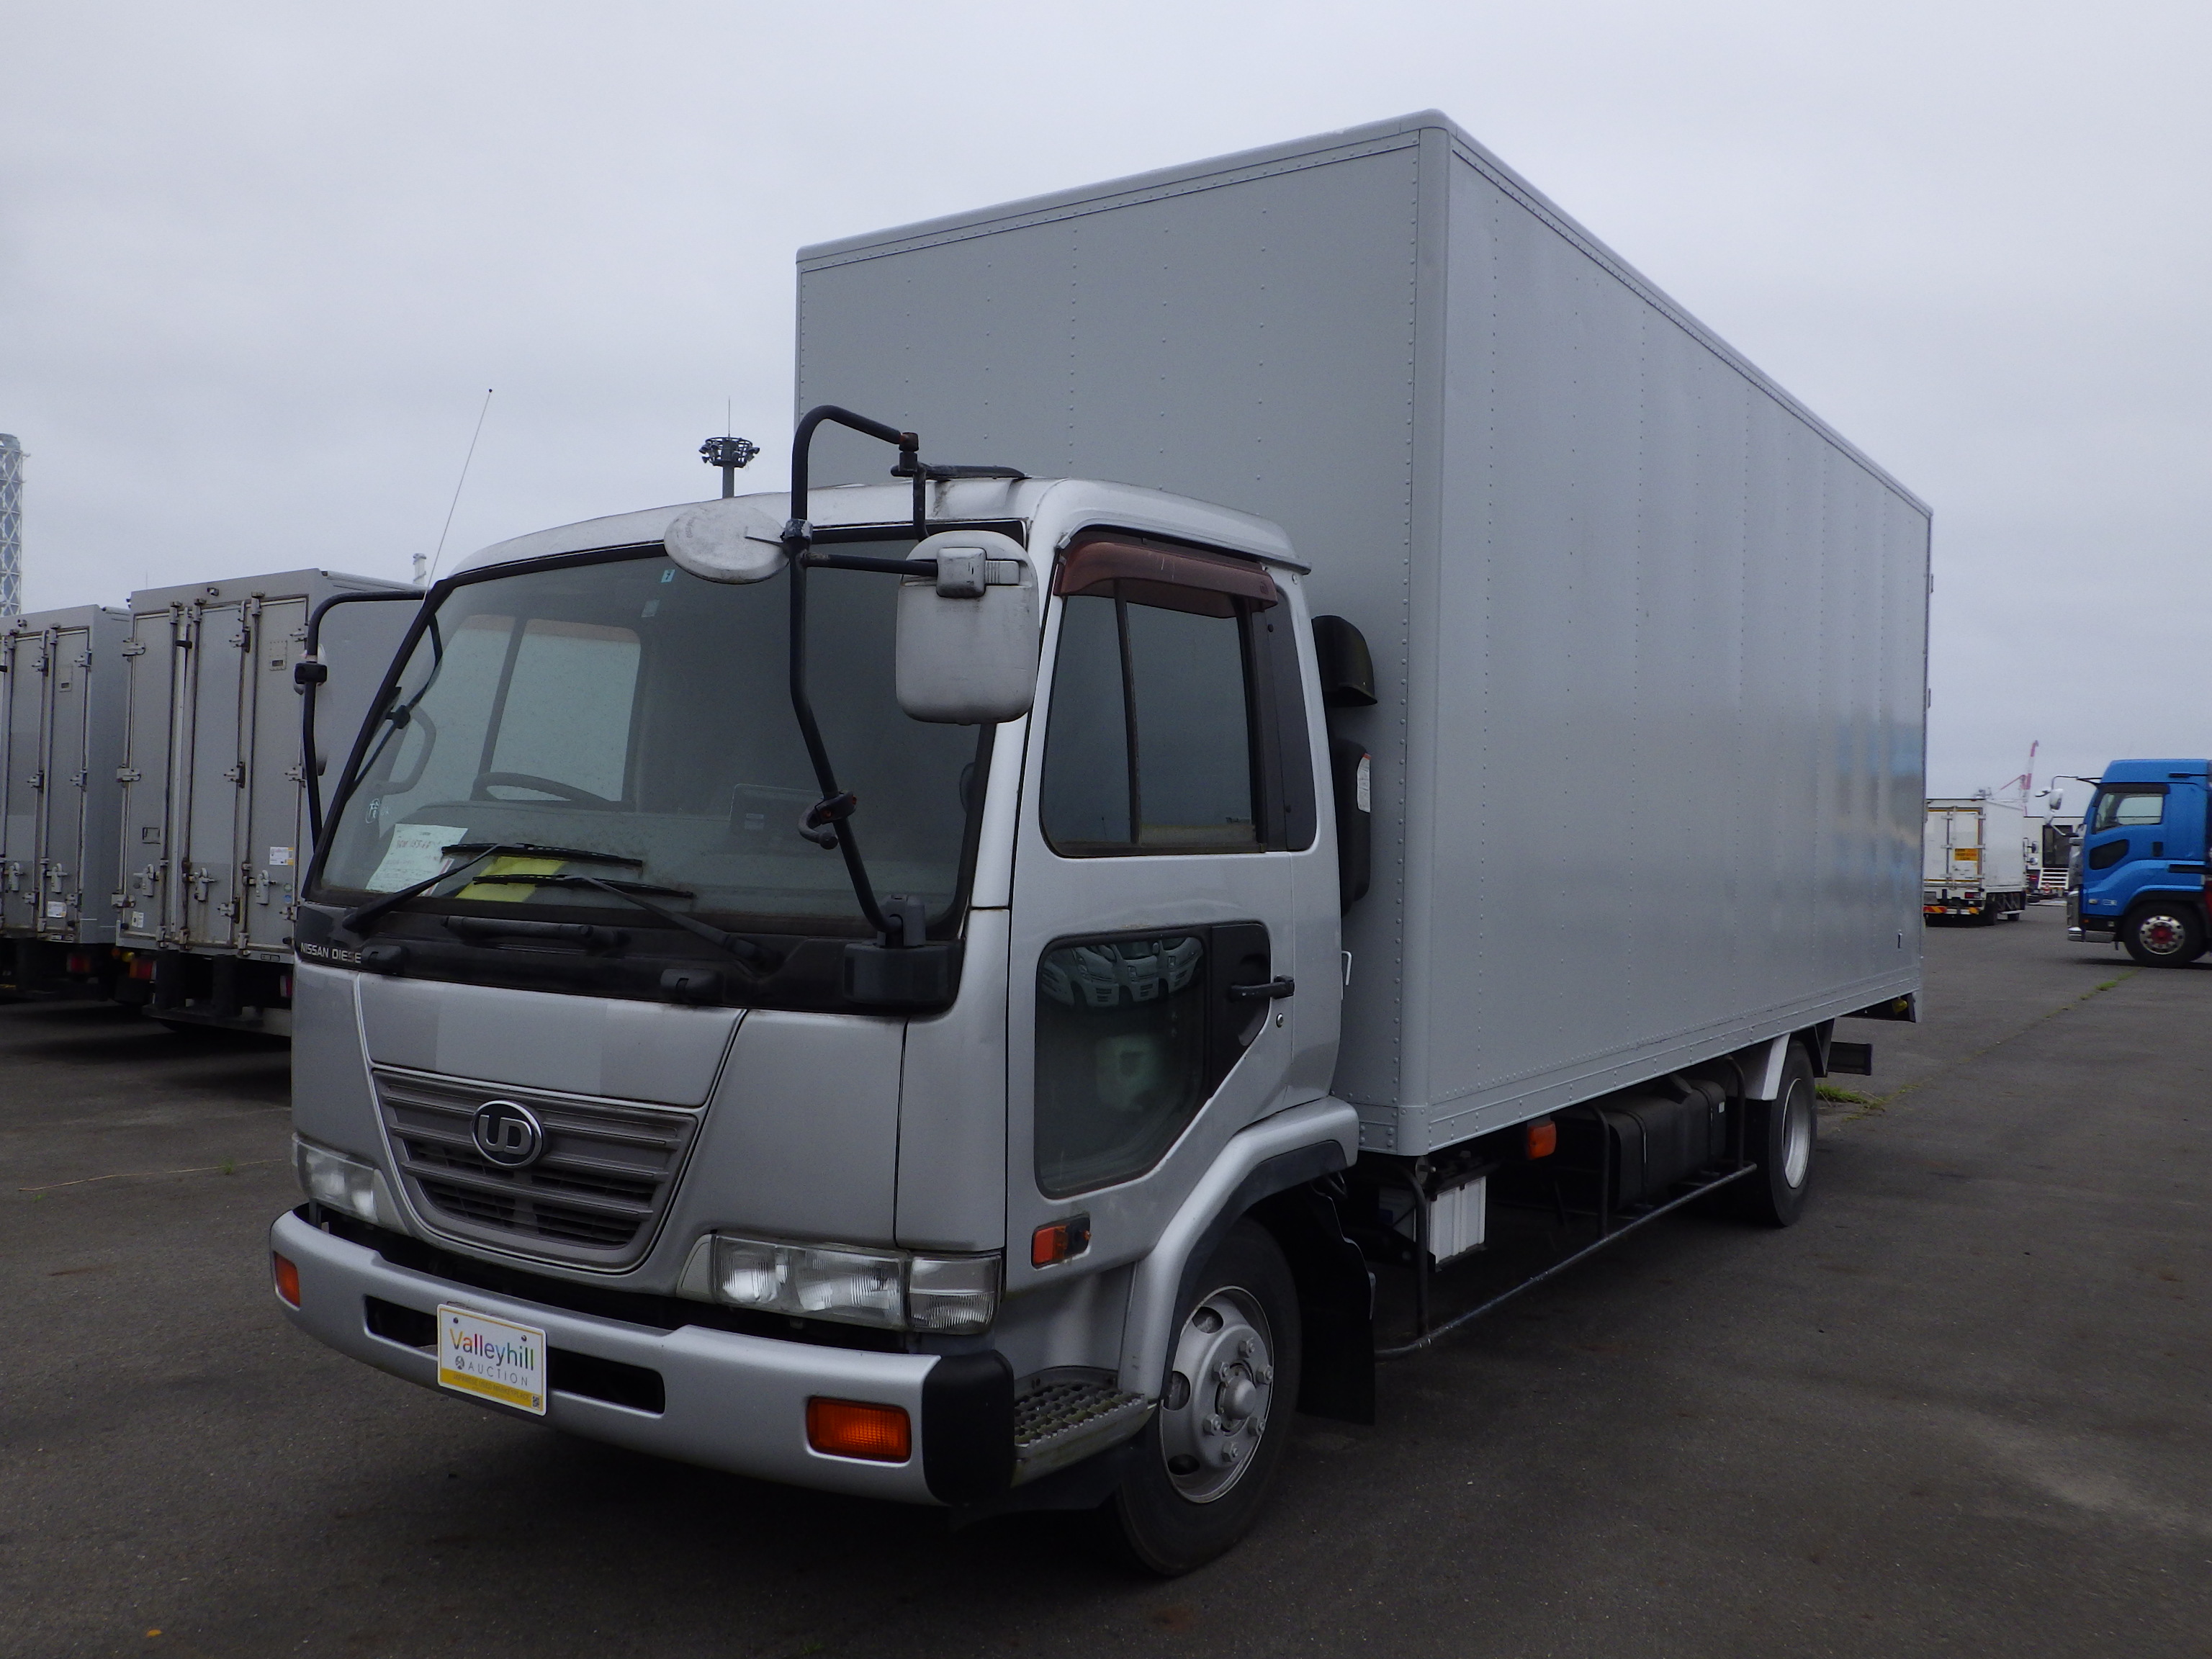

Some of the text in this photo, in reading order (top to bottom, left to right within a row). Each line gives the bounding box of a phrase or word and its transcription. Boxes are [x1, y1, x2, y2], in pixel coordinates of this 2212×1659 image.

[301, 942, 361, 963] NISSAN DIESE
[477, 1114, 532, 1155] UD
[450, 1328, 534, 1371] Valleyhill
[468, 1362, 528, 1387] AUCTION
